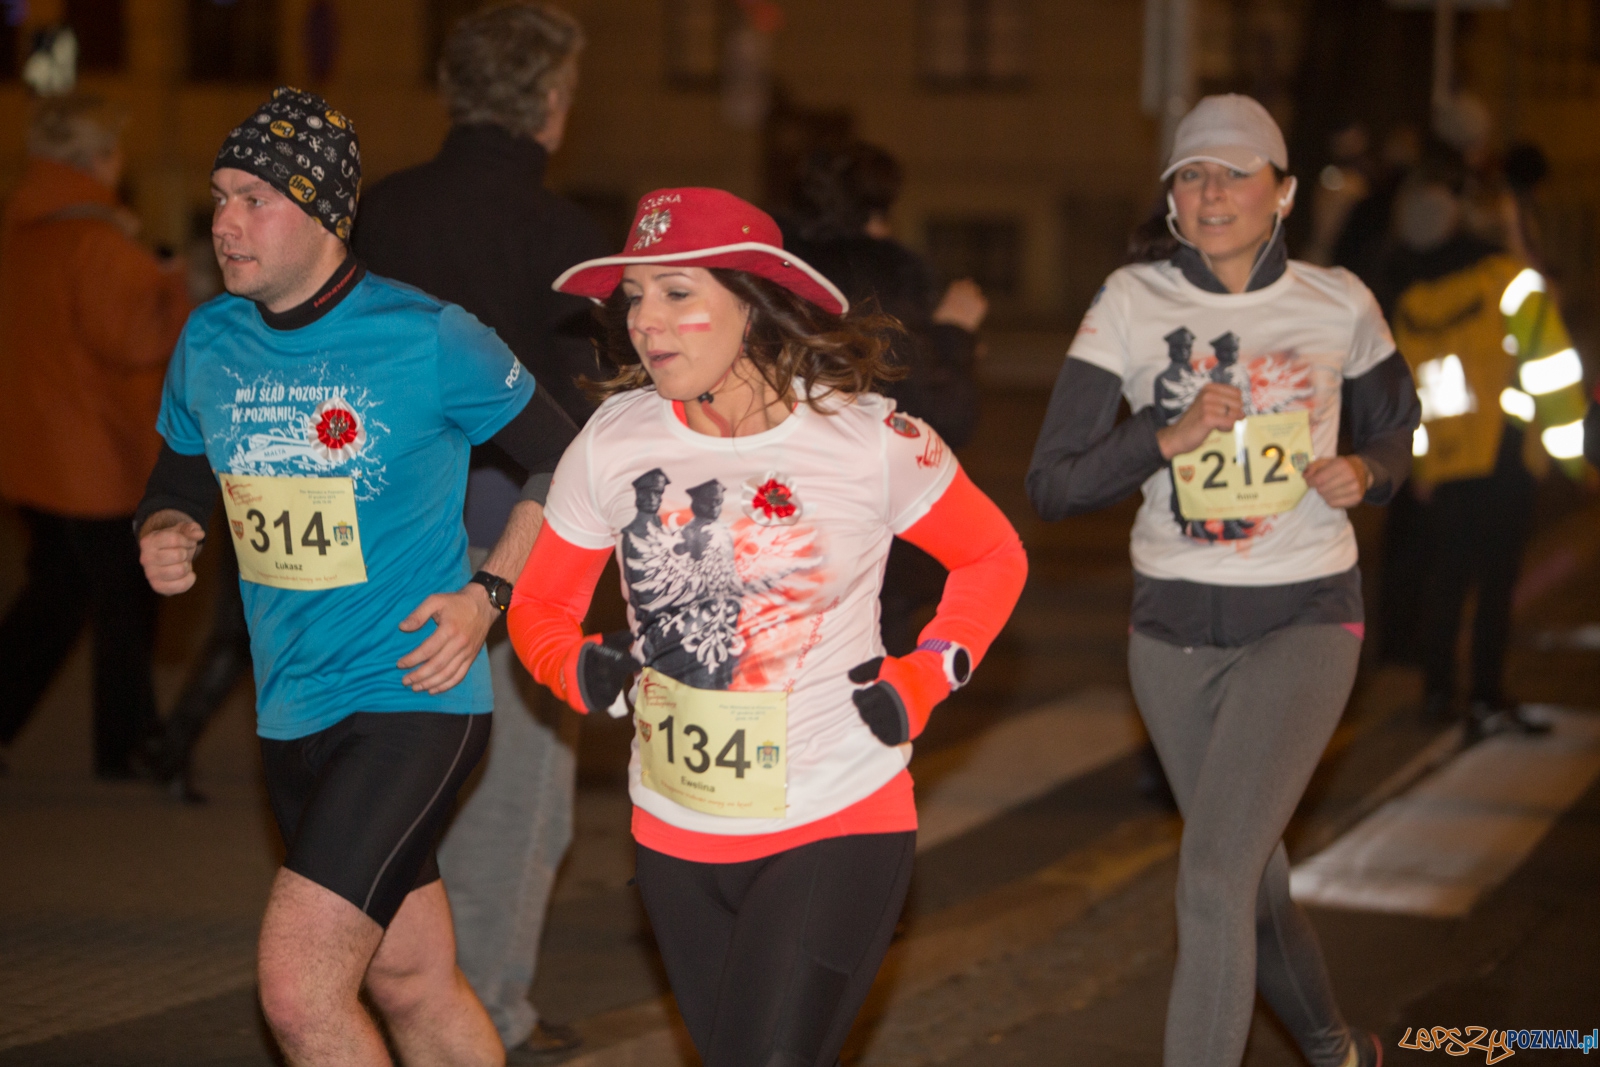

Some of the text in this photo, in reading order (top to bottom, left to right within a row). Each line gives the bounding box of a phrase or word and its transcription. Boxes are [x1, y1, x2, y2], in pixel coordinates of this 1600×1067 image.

[289, 174, 316, 201] Buff
[231, 405, 297, 424] W POZNANIU
[263, 448, 287, 458] MALTA
[1200, 442, 1290, 490] 212
[246, 508, 332, 556] 314
[274, 560, 304, 572] Łukasz
[658, 714, 752, 779] 134
[680, 775, 716, 793] Ewelina
